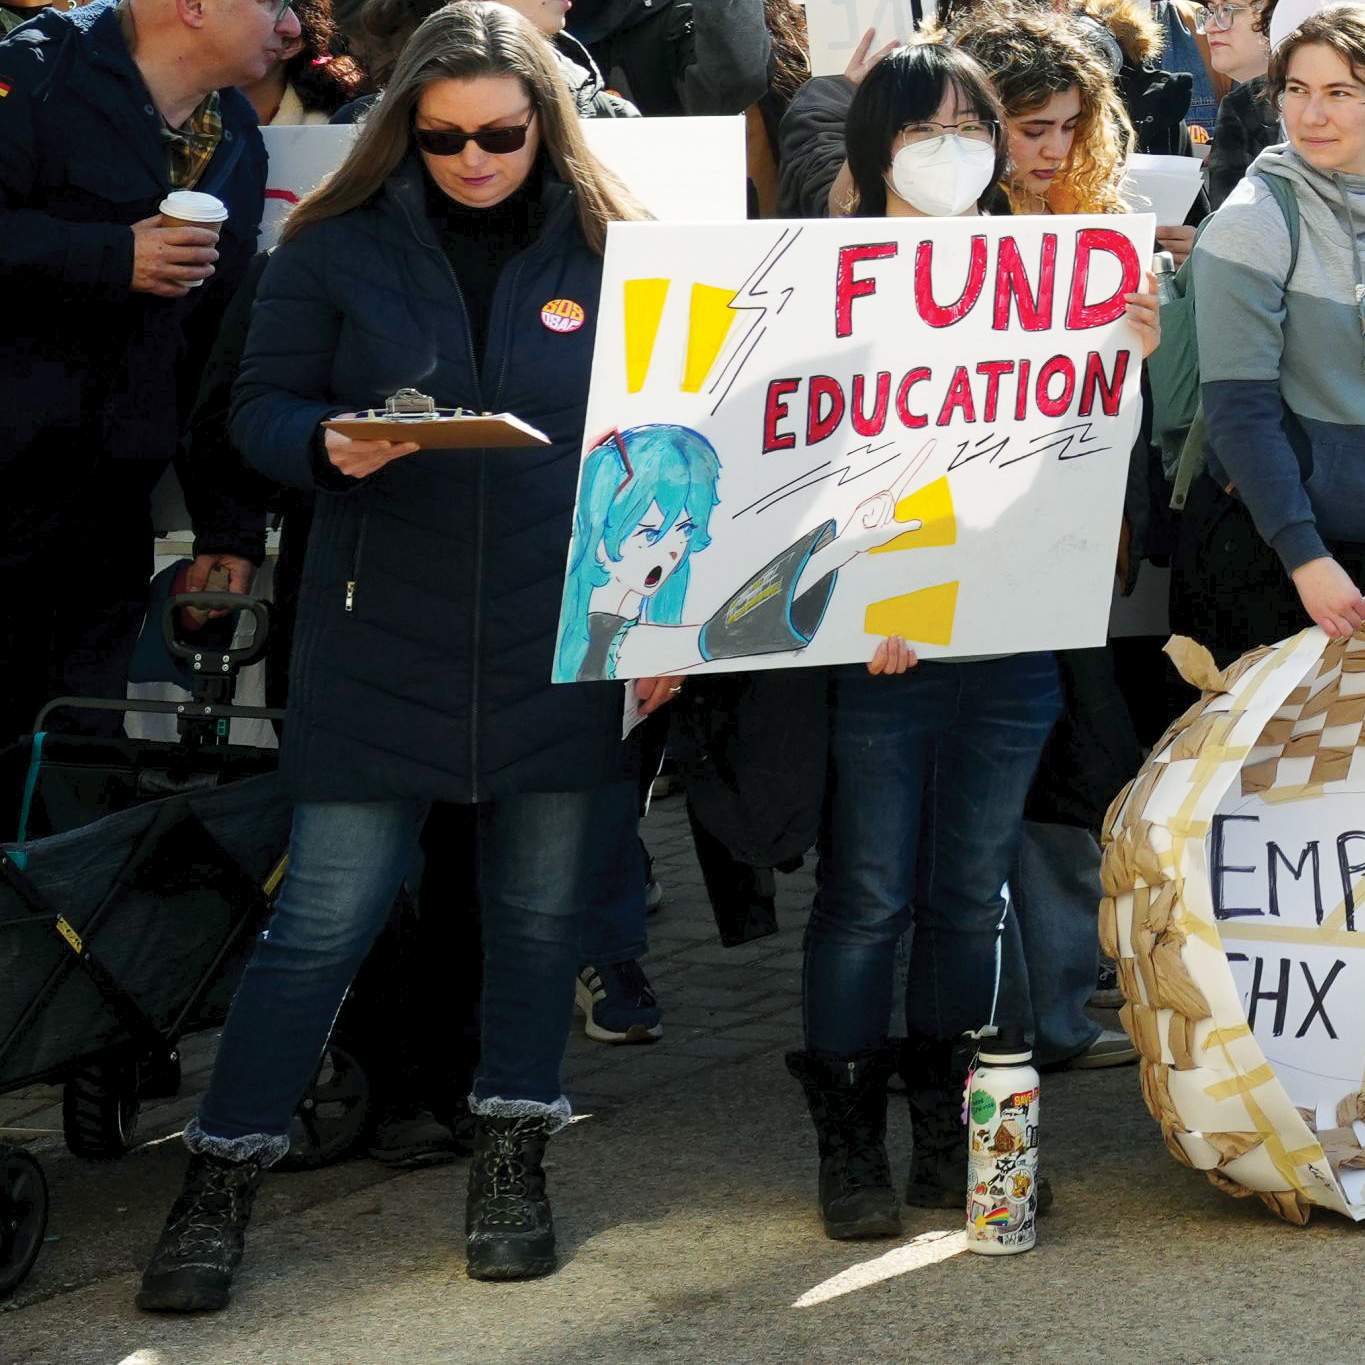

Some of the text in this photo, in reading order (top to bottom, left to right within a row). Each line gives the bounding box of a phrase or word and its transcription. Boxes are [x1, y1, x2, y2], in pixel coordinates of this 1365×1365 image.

[541, 298, 585, 321] SOS
[835, 228, 1141, 338] FUND
[761, 350, 1131, 455] EDUCATION
